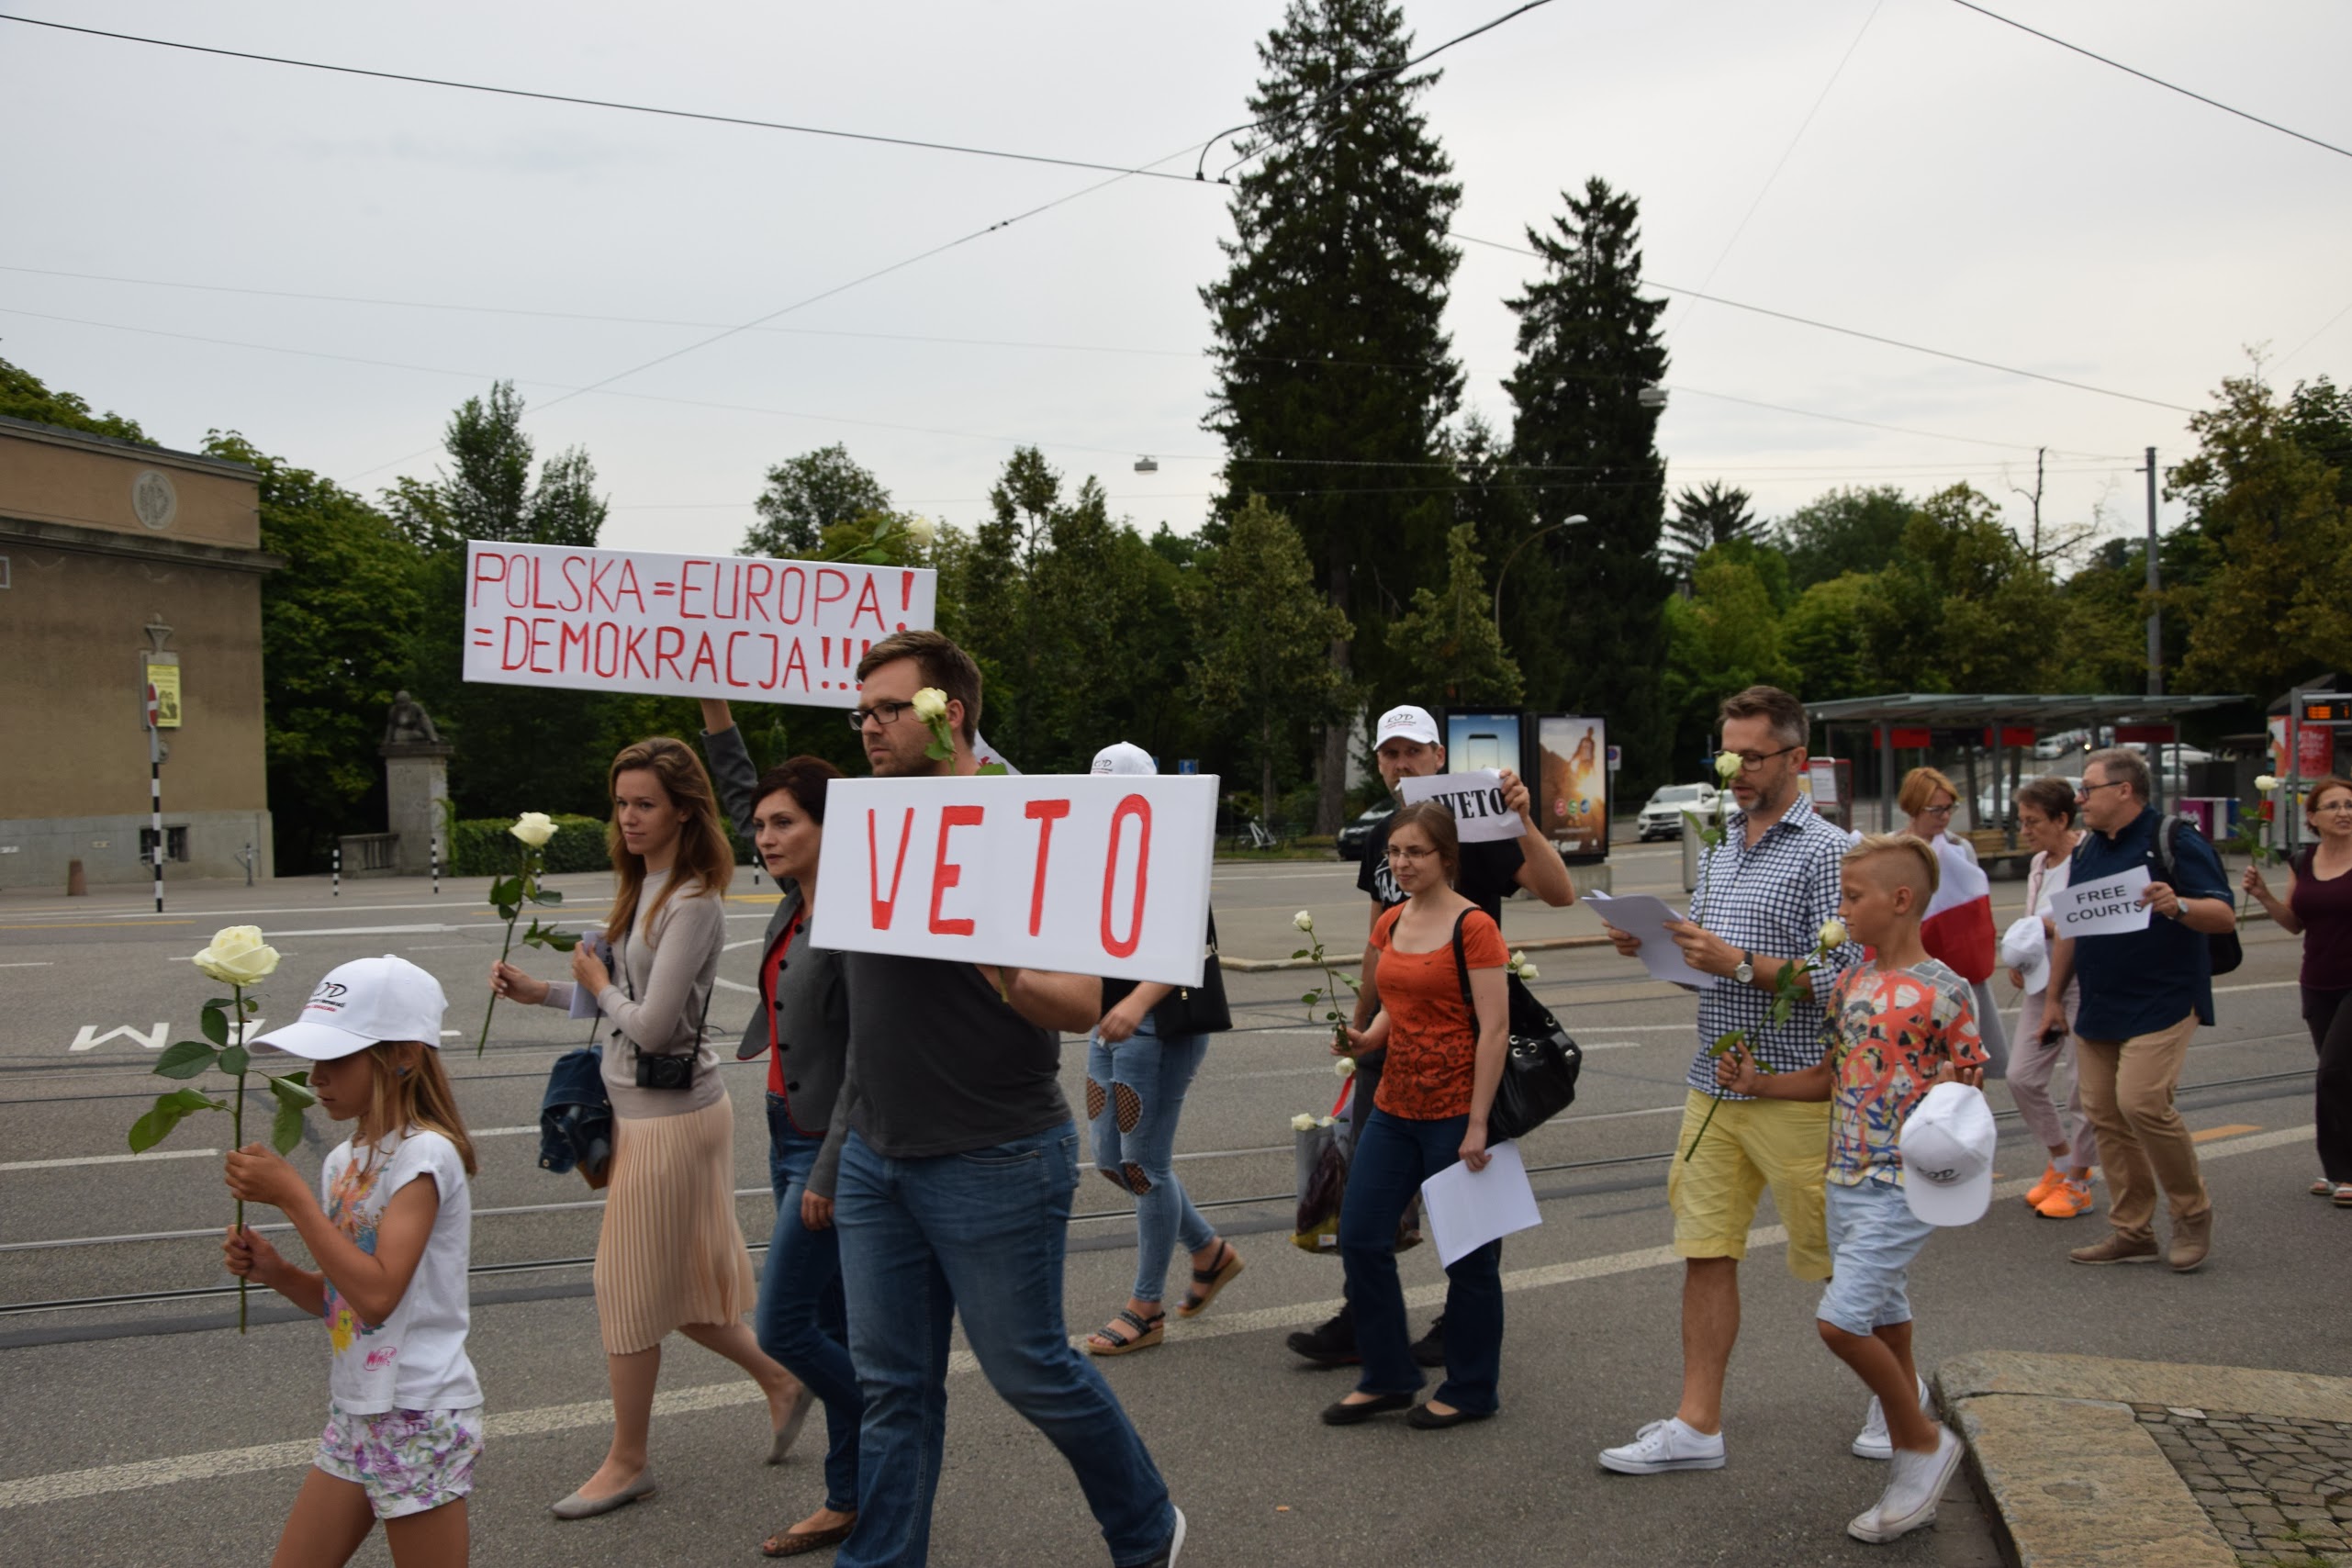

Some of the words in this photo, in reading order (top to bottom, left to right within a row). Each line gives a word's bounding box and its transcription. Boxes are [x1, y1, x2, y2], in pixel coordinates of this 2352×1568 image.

[868, 793, 1152, 958] VETO
[2076, 885, 2127, 904] FREE
[2066, 900, 2144, 924] COURTS
